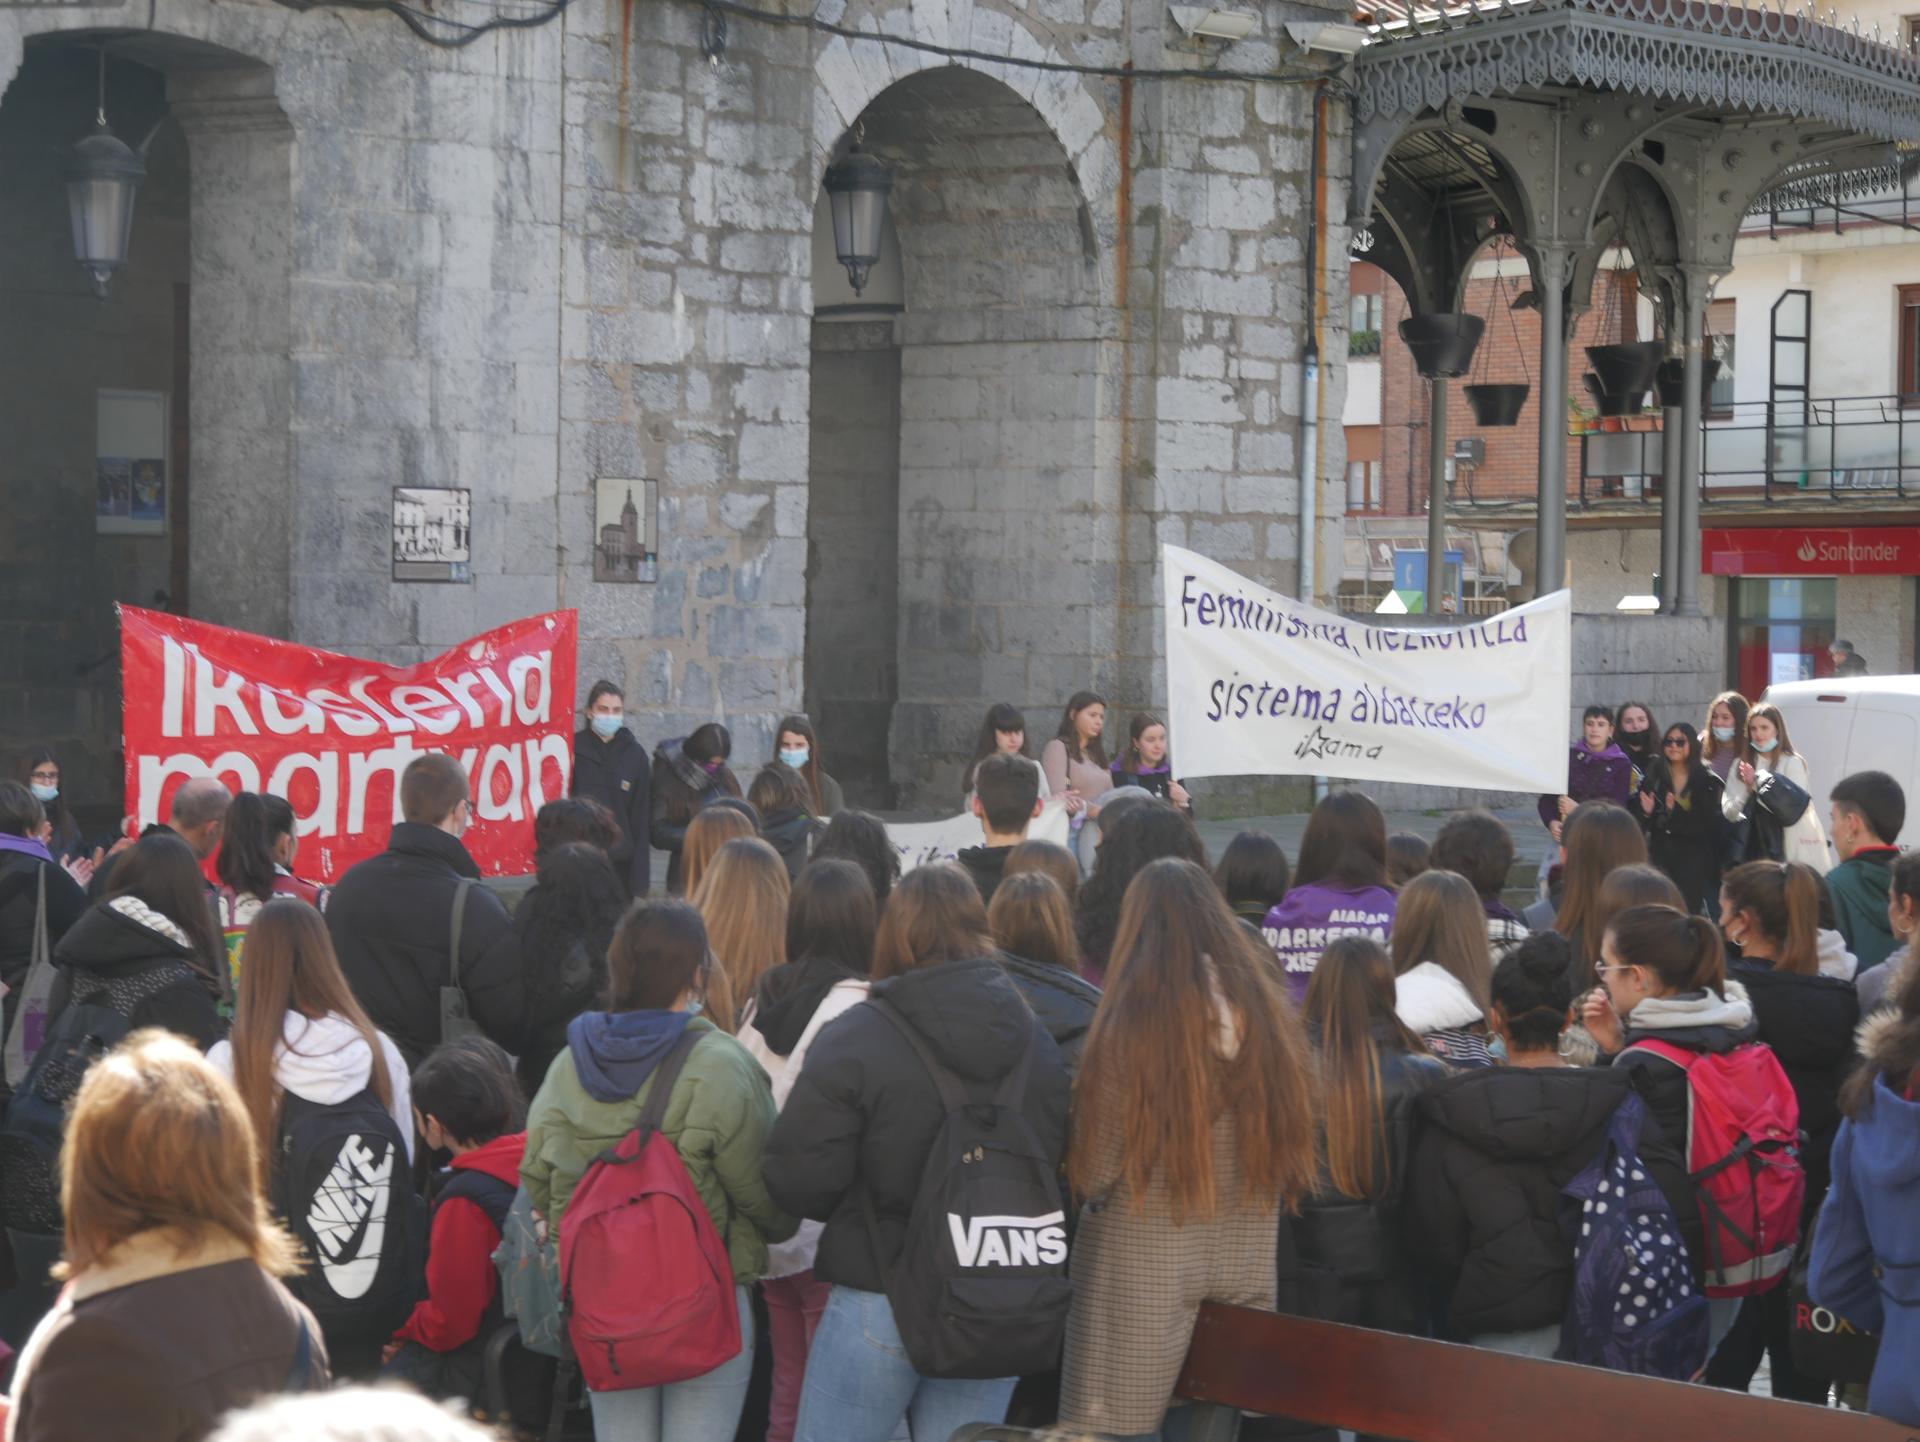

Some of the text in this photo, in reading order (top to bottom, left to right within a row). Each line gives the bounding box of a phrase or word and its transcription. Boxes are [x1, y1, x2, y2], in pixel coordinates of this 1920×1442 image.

[1818, 541, 1900, 562] Santander
[1207, 671, 1341, 724] sistema
[947, 1210, 1067, 1267] VANS
